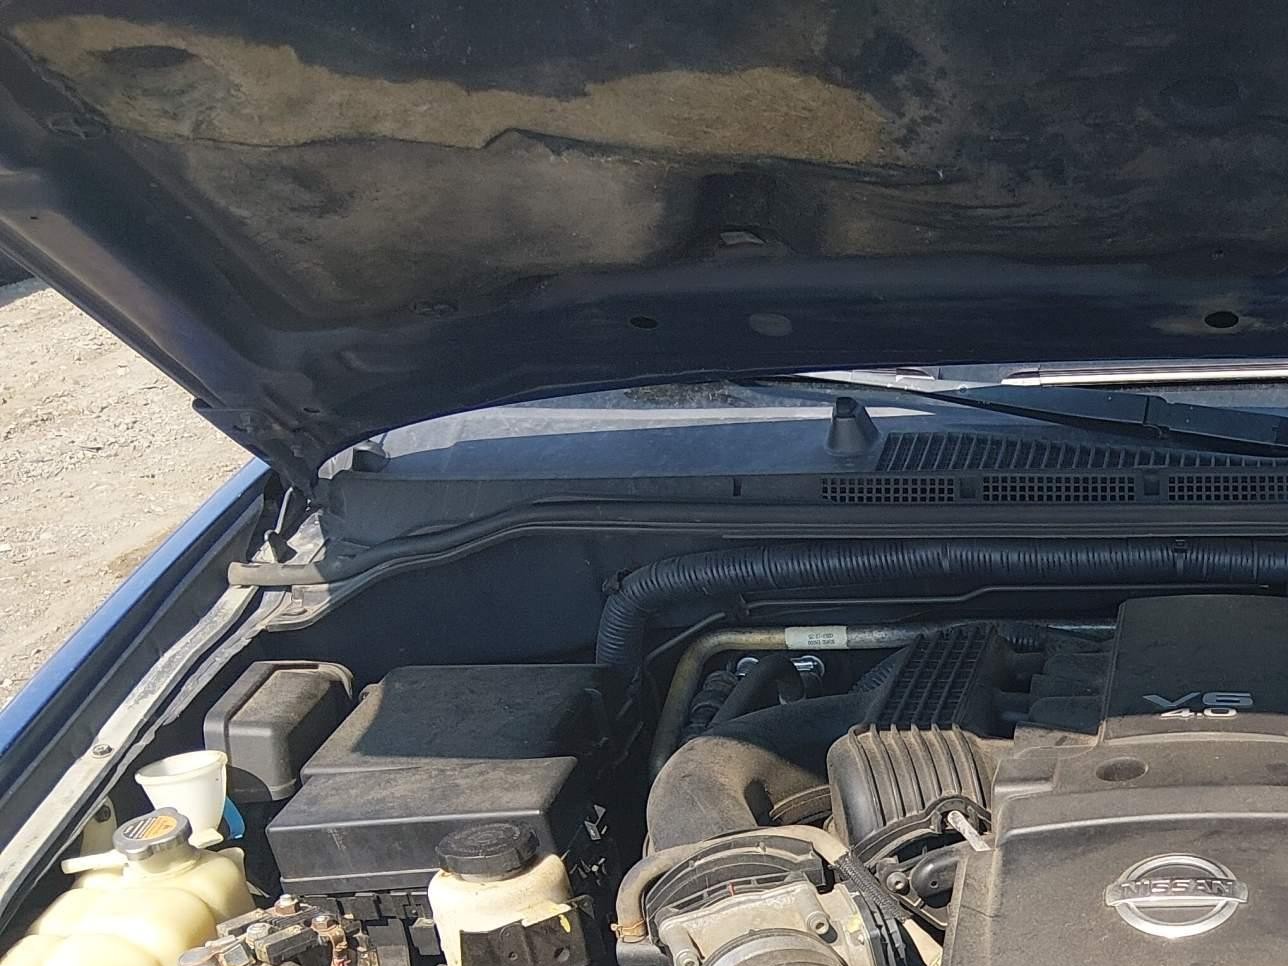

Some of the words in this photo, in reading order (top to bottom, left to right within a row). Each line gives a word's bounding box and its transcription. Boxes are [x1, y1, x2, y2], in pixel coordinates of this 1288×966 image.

[1142, 691, 1254, 708] V6
[1160, 707, 1238, 719] 4.0
[1120, 880, 1233, 898] NISSAN
